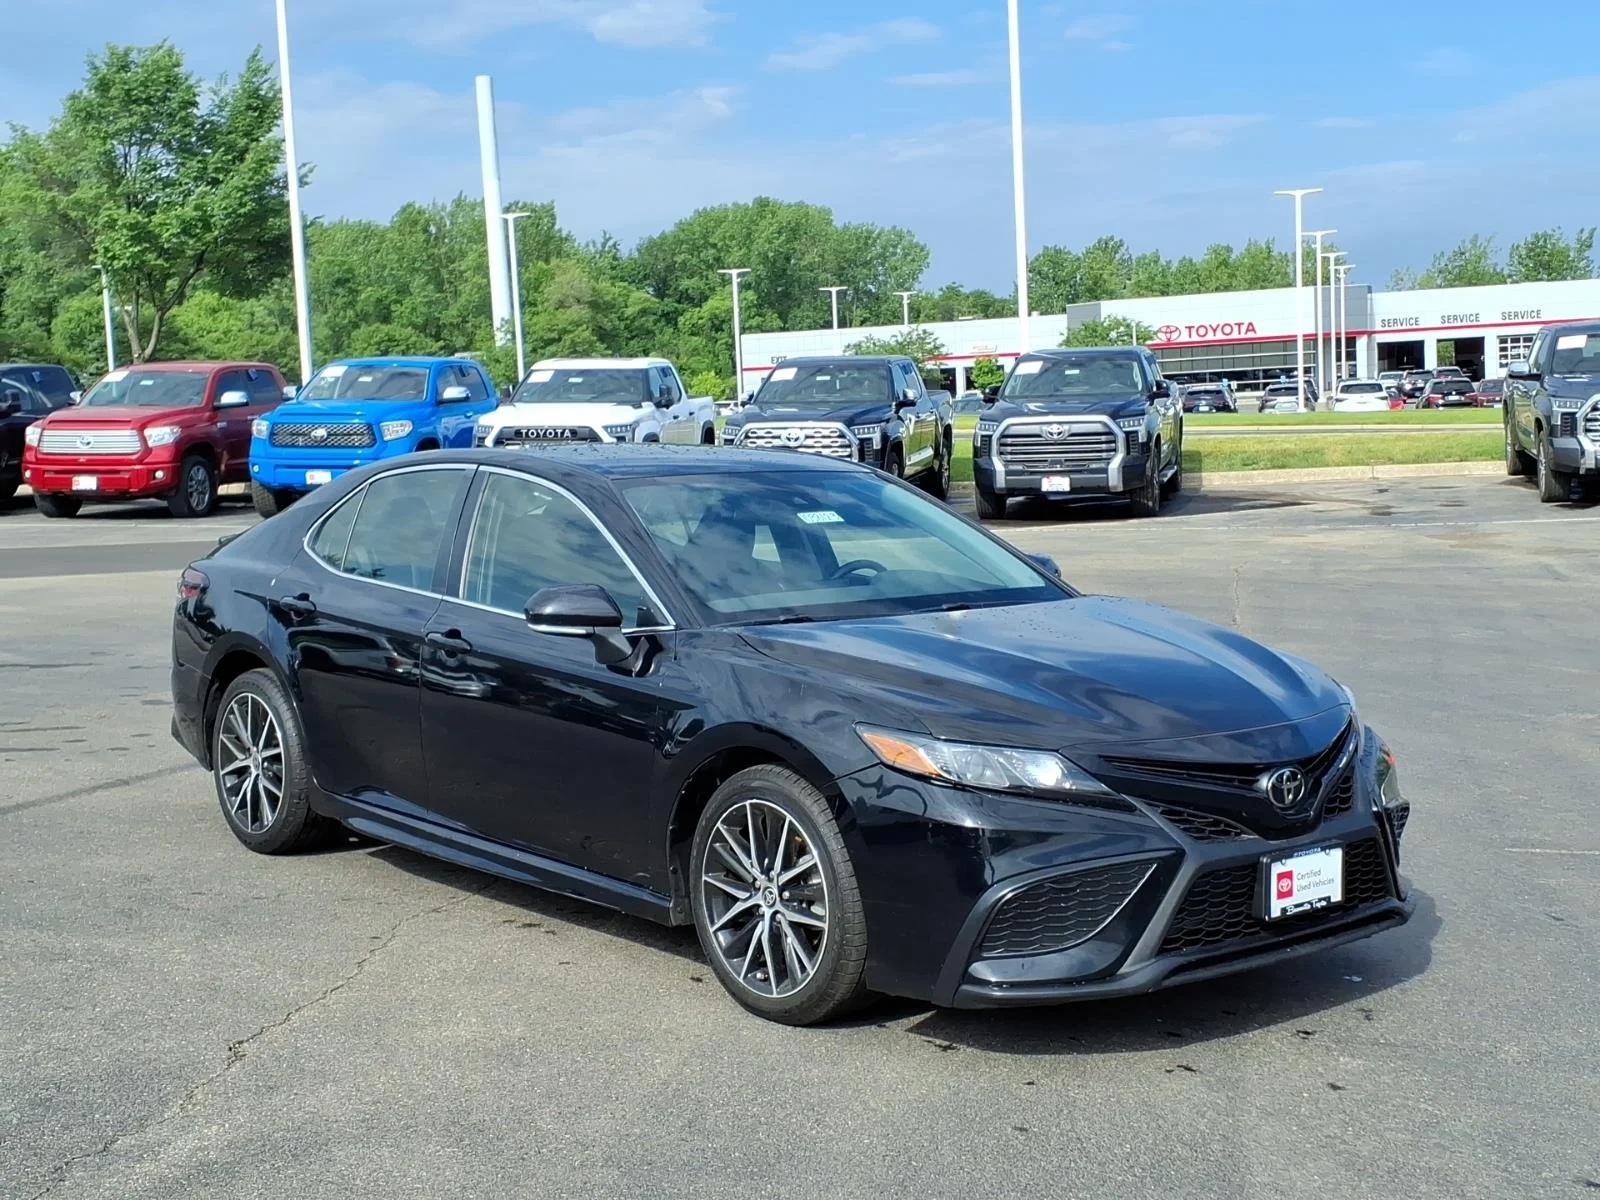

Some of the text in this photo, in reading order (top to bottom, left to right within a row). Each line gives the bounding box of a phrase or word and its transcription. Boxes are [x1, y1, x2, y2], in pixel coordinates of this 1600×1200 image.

[1440, 313, 1480, 325] SERVICE
[1501, 309, 1542, 321] SERVICE
[1380, 317, 1420, 328] SERVICE
[1184, 322, 1257, 339] TOYOTA
[520, 429, 572, 439] TOYOTA
[1297, 867, 1322, 881] Certified
[1297, 877, 1335, 892] Used Vehicles
